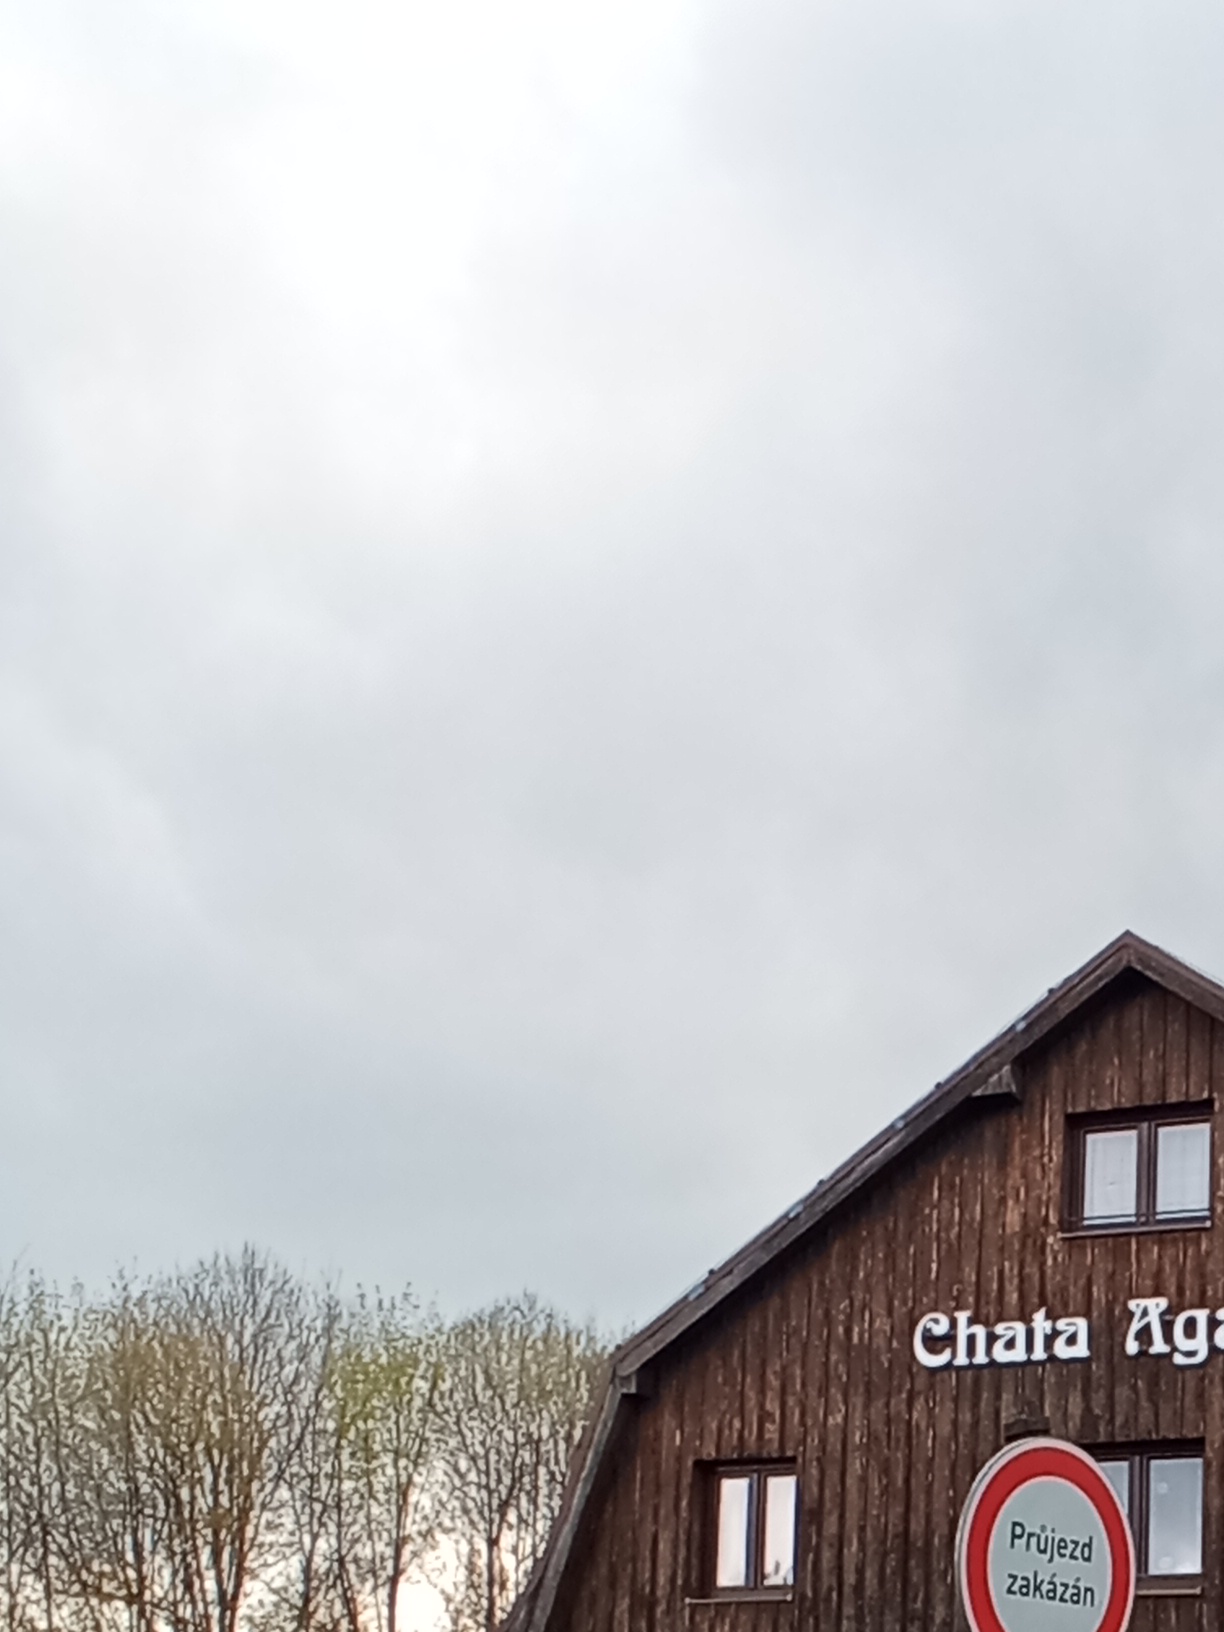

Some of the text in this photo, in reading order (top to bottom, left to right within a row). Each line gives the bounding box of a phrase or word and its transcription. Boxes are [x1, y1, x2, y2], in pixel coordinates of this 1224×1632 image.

[913, 1306, 1091, 1369] Chata
[1009, 1521, 1094, 1564] Průjezd
[1005, 1569, 1095, 1608] zakázán
